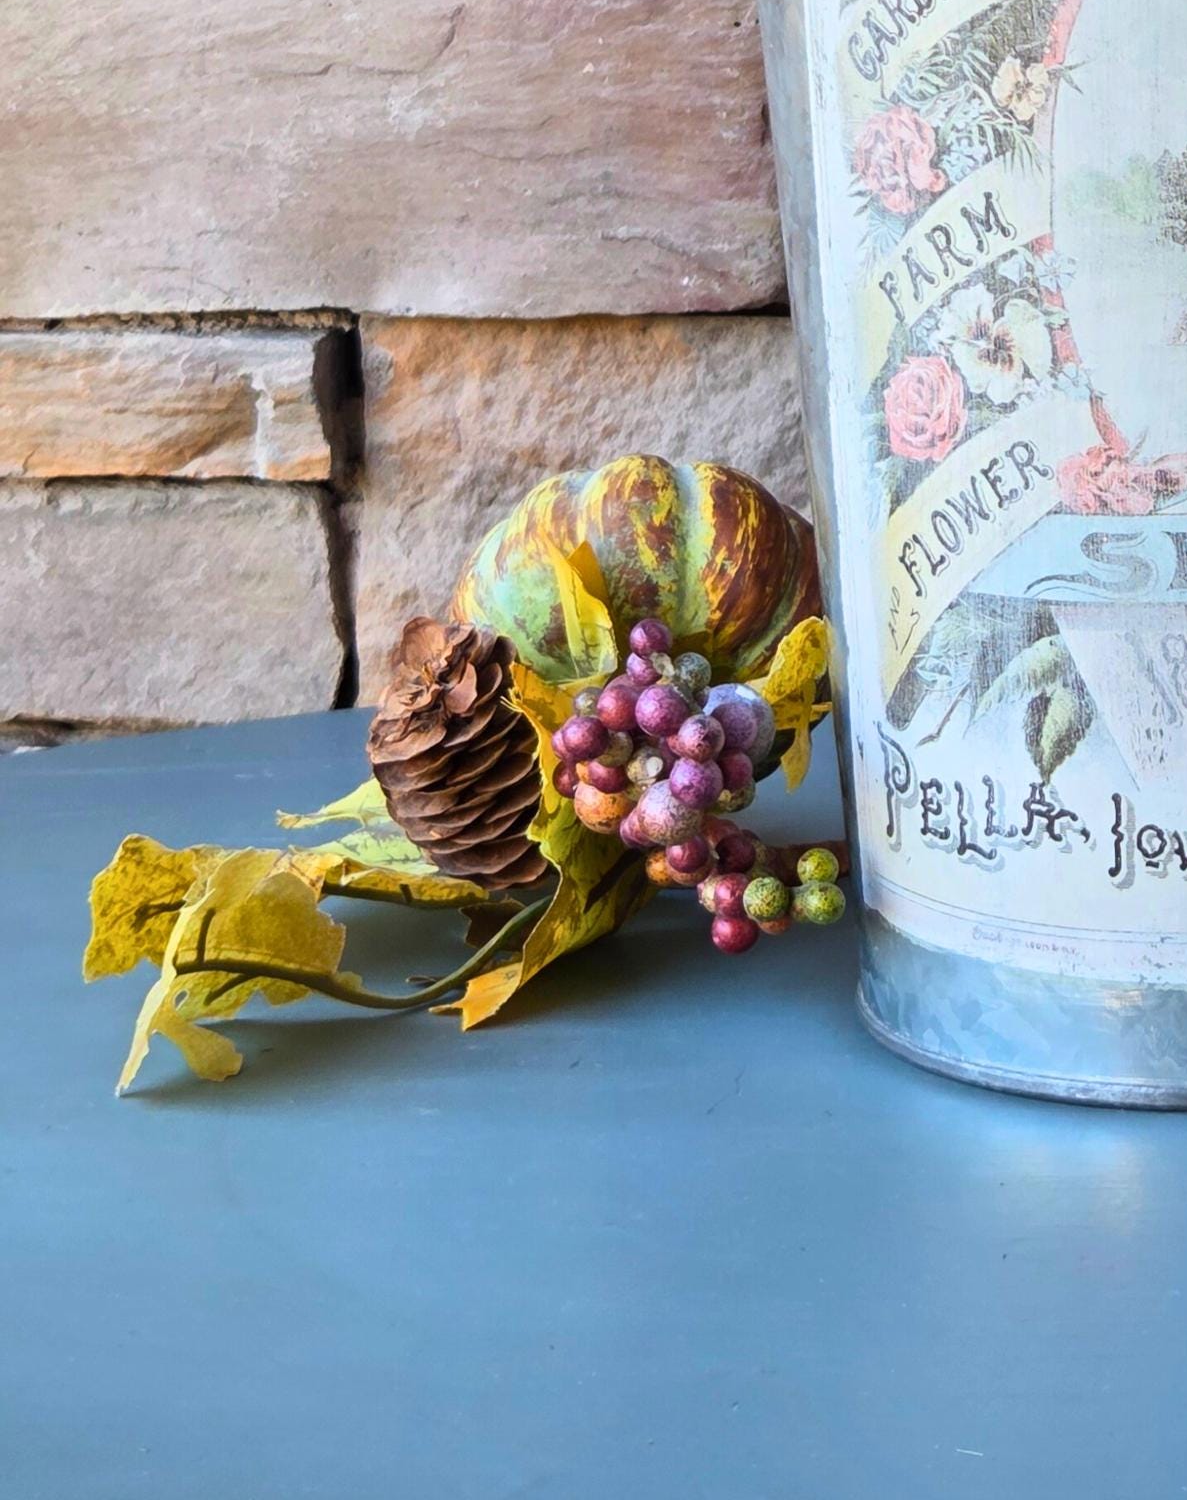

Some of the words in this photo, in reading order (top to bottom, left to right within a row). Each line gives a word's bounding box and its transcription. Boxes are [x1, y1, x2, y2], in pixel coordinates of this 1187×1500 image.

[878, 191, 1016, 320] FARM
[898, 440, 1053, 599] FLOWER
[873, 720, 1091, 866] PELLA,
